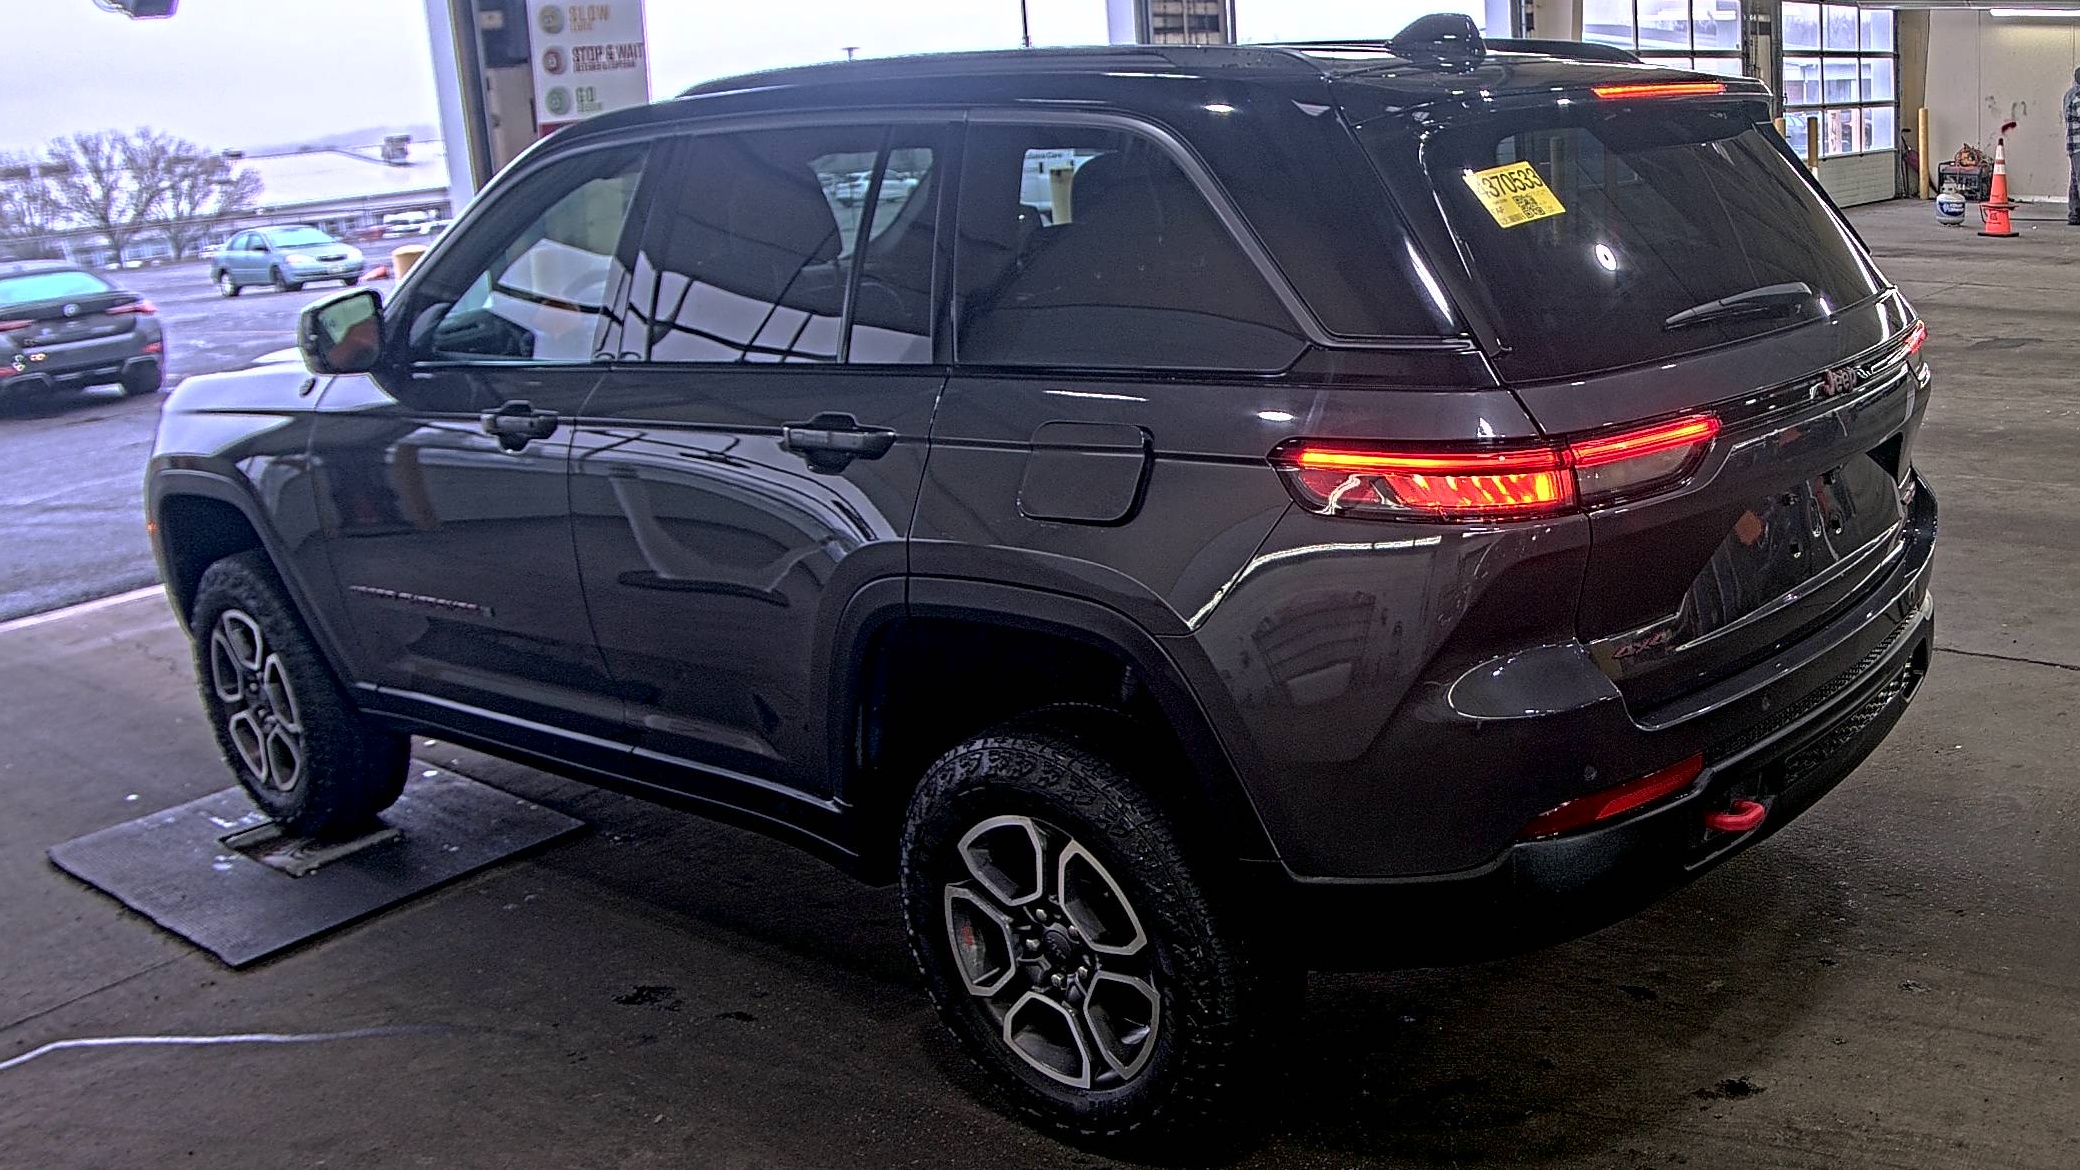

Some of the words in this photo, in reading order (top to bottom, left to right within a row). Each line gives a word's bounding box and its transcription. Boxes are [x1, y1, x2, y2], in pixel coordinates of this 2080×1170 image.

[568, 4, 610, 22] SLOW
[572, 46, 604, 63] STOP
[617, 42, 643, 59] WAIT
[575, 86, 595, 103] GO
[1821, 365, 1857, 396] Jeep
